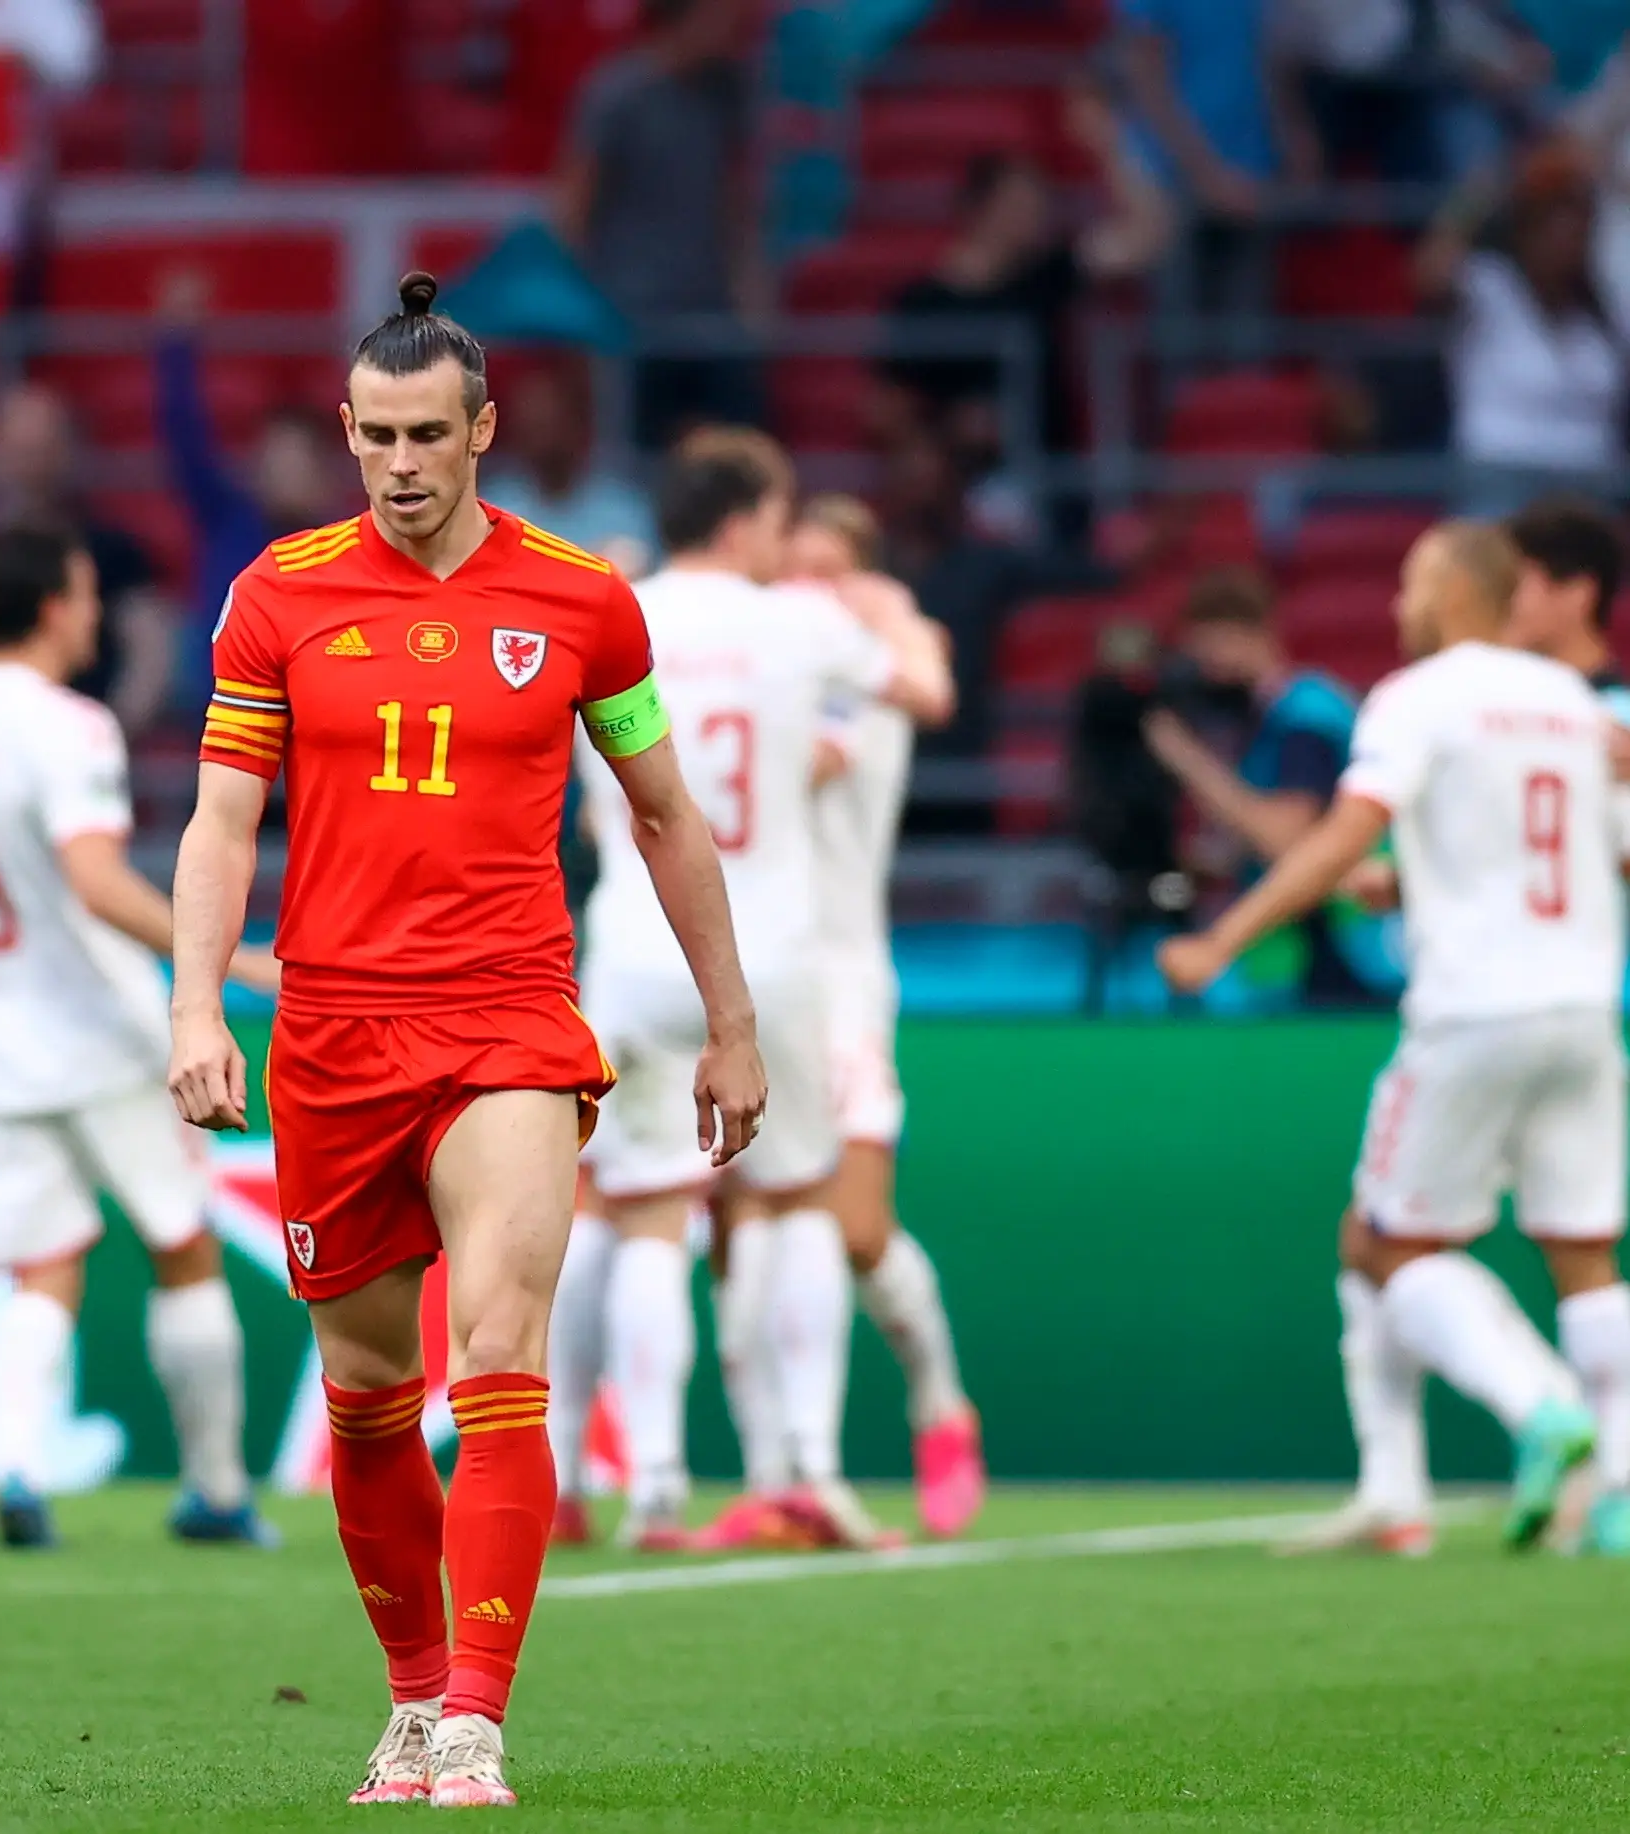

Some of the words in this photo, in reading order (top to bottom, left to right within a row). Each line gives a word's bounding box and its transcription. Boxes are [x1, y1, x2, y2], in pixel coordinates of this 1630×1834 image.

[324, 644, 372, 657] adidas
[370, 701, 456, 796] 11
[1524, 772, 1570, 921] 9
[461, 1610, 516, 1624] adidas
